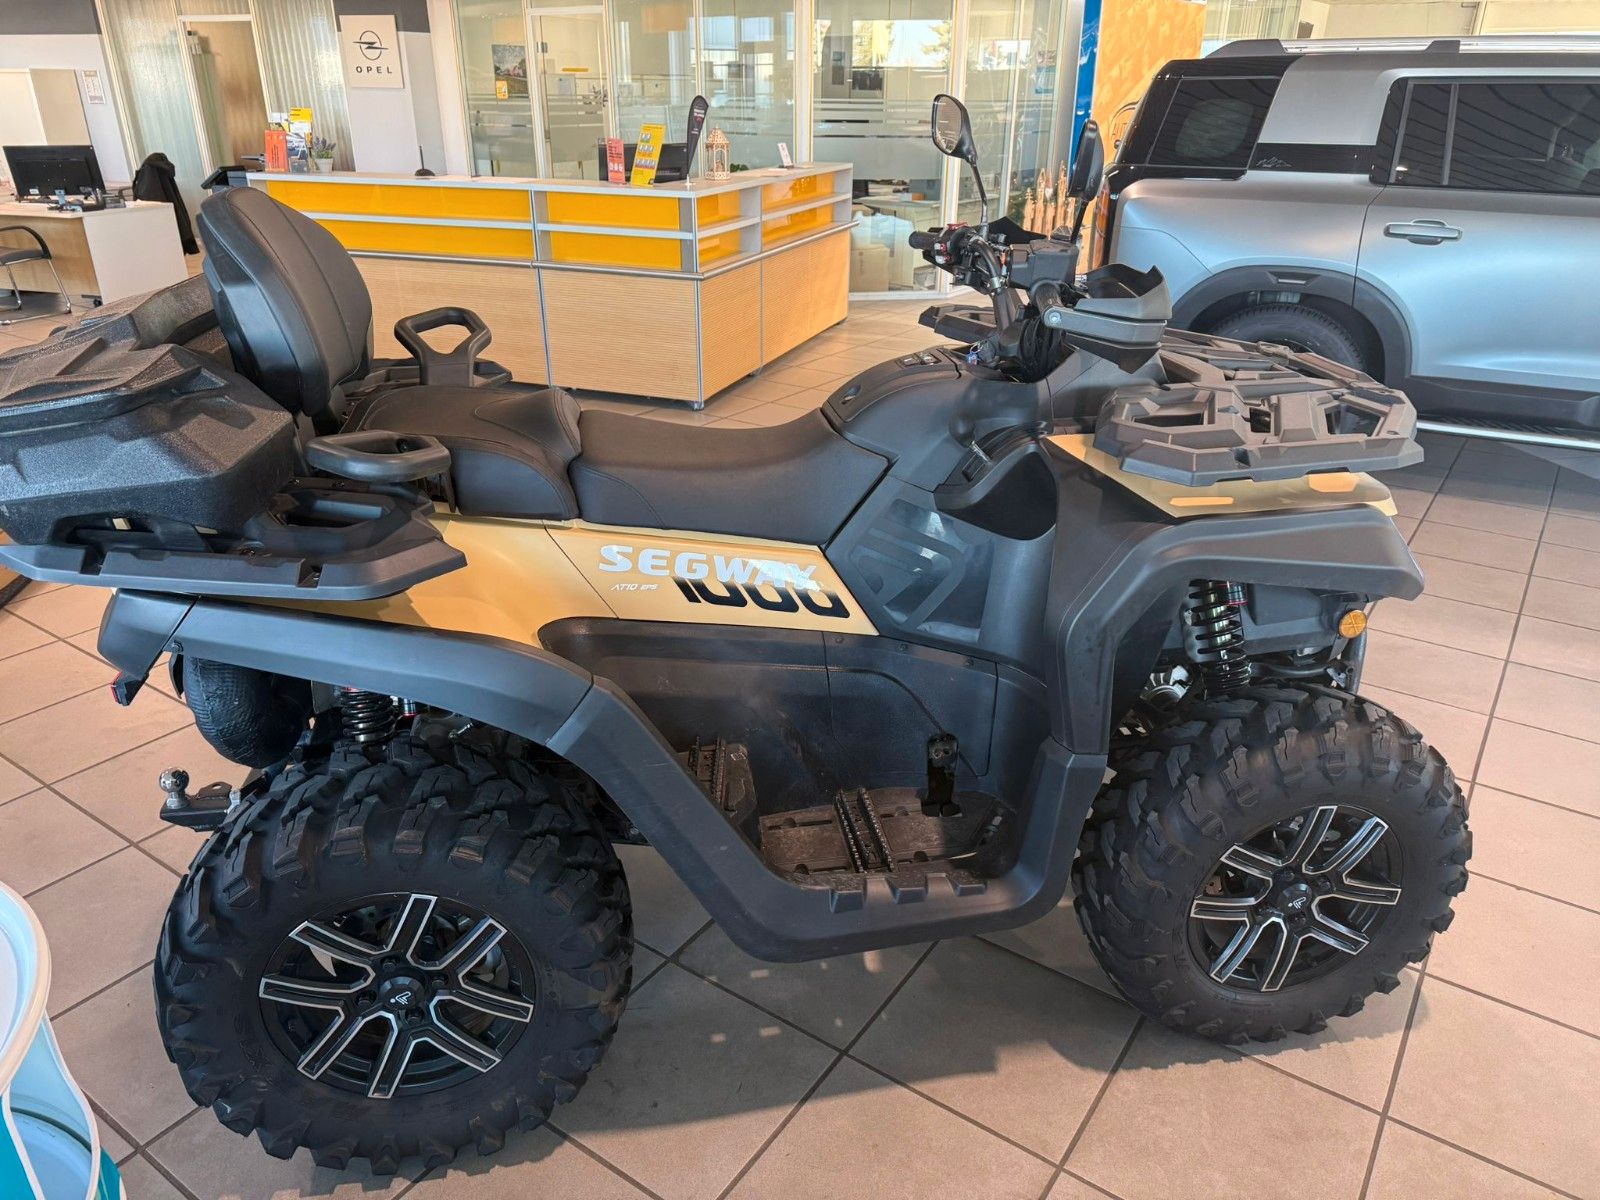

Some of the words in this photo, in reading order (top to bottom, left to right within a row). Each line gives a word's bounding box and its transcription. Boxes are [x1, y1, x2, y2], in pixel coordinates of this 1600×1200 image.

[355, 65, 393, 74] OPEL
[599, 545, 817, 591] SEGWAY
[672, 576, 850, 619] 1000
